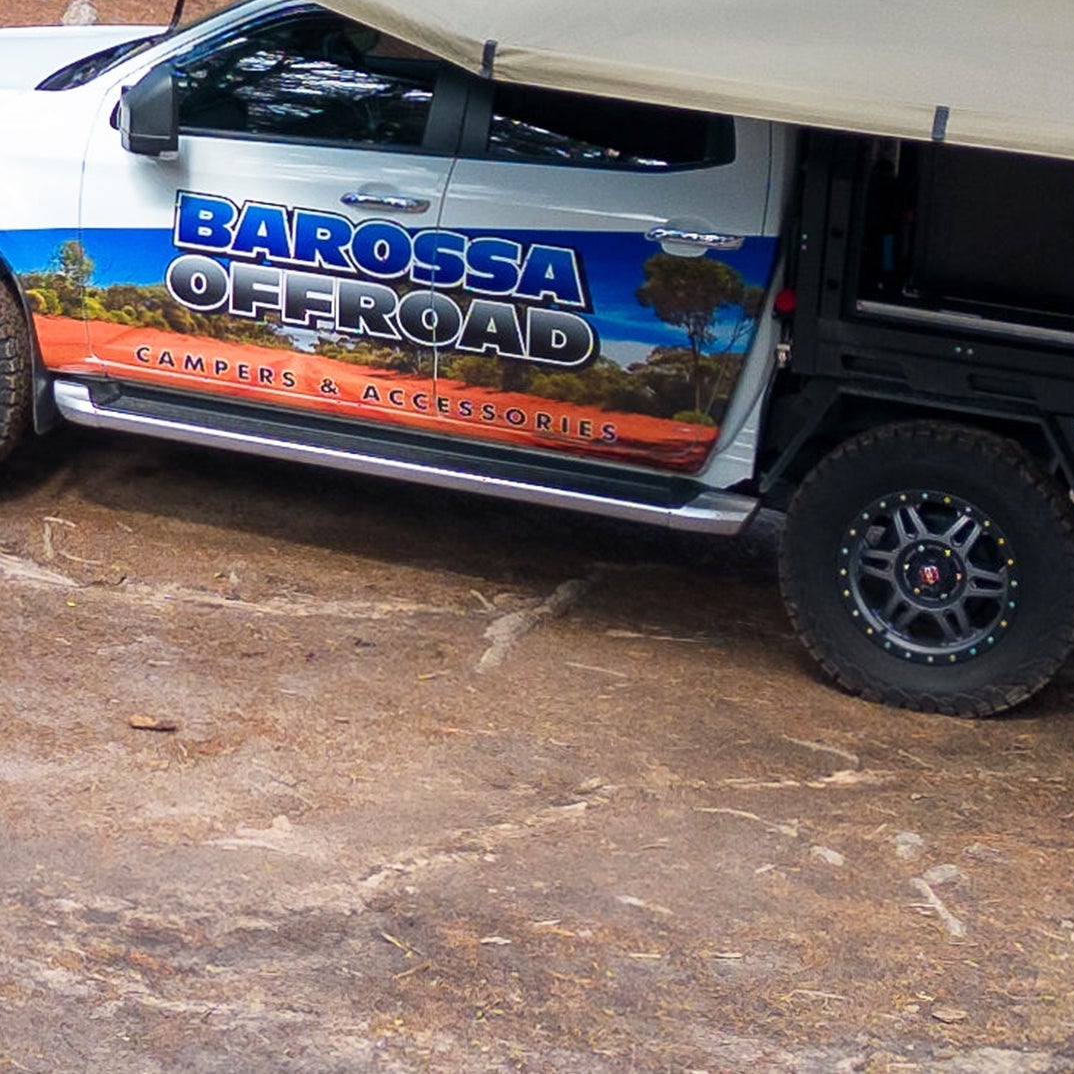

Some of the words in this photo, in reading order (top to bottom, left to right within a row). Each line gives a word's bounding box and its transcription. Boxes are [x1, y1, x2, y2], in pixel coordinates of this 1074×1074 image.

[175, 191, 586, 308] BAROSSA
[165, 253, 596, 366] OFFROAD
[135, 346, 296, 388] CAMPERS
[320, 377, 339, 396] &
[362, 385, 618, 443] ACCESSORIES
